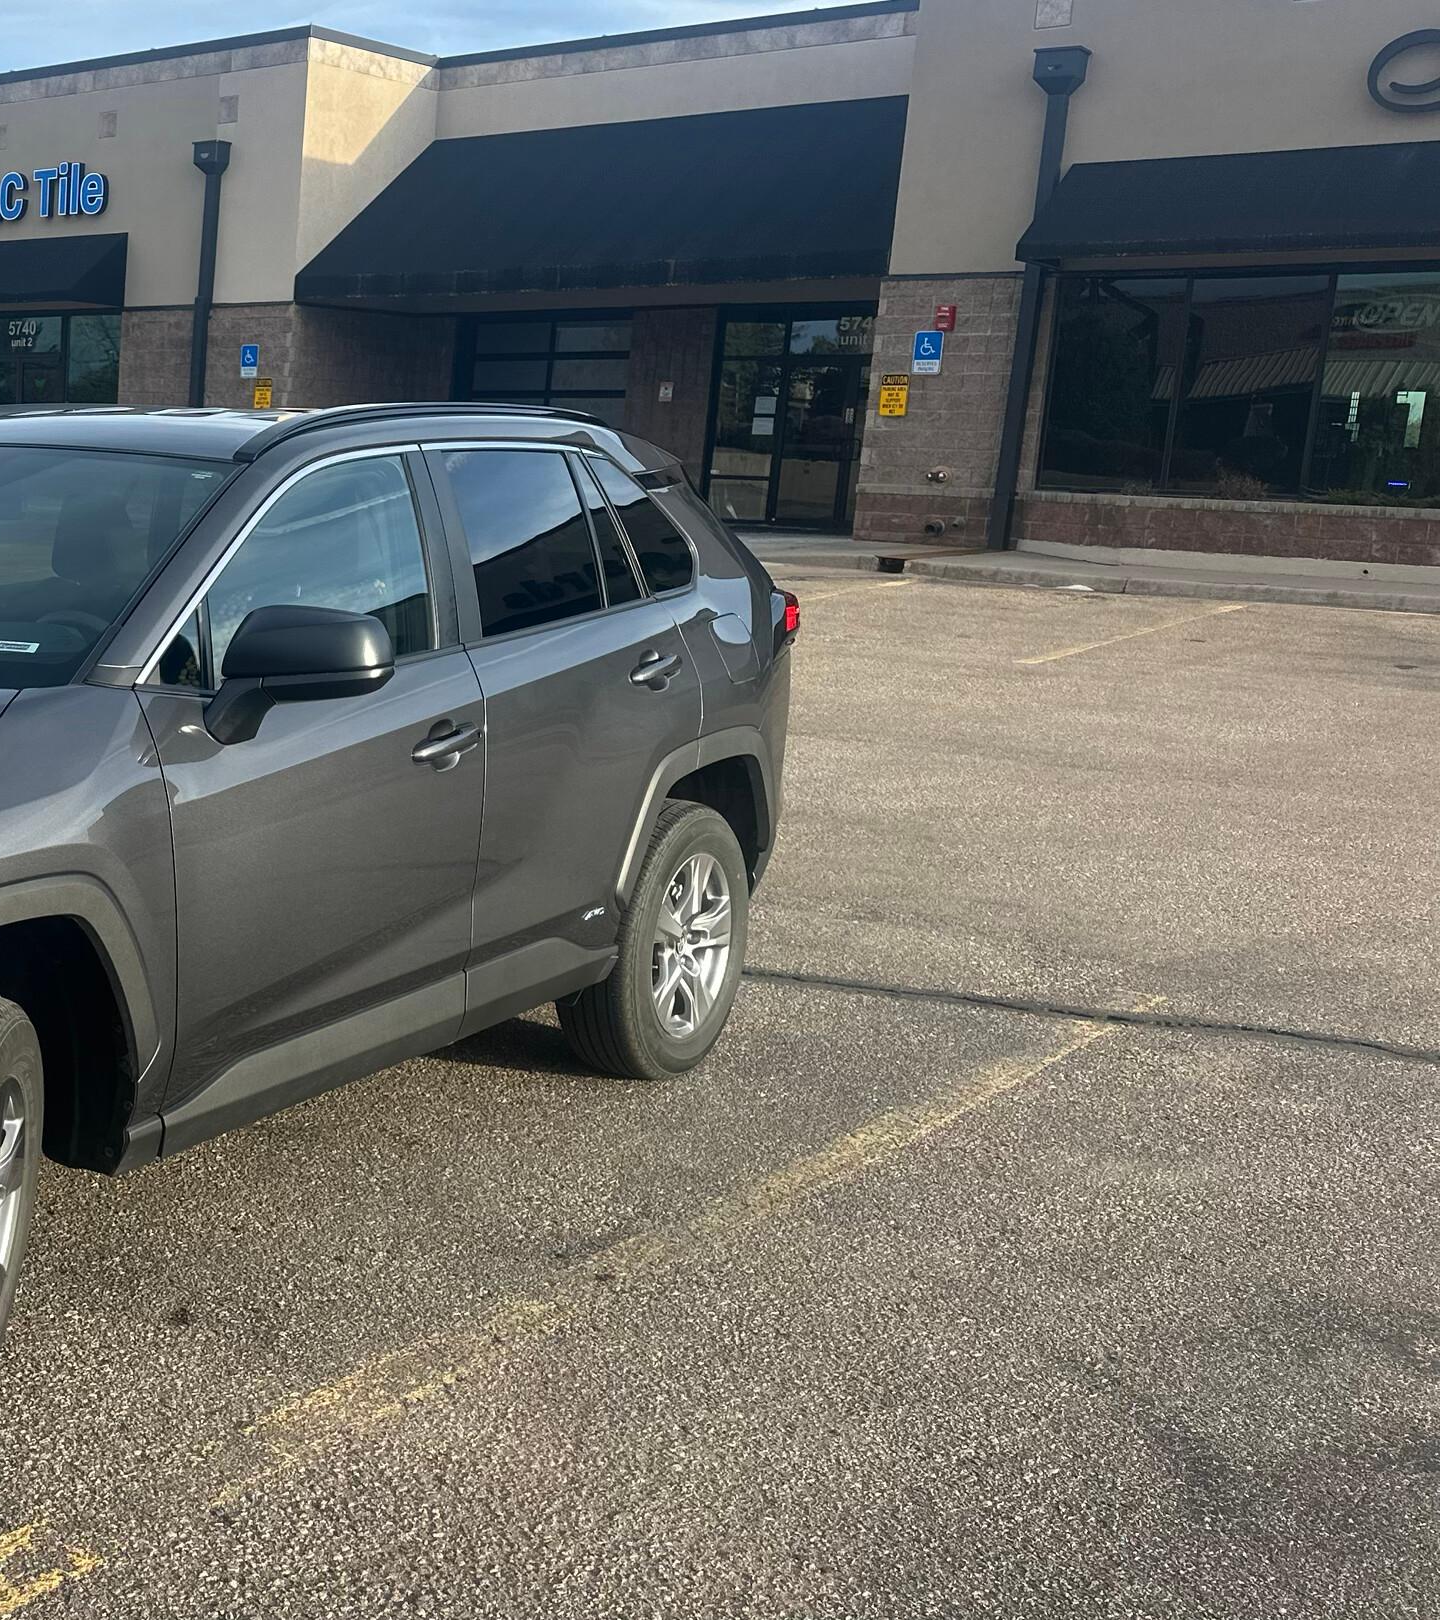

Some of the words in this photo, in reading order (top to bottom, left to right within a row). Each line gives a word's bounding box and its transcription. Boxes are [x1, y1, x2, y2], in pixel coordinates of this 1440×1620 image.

[33, 162, 106, 218] Tile
[8, 321, 36, 336] 5740
[11, 338, 26, 347] unit
[27, 338, 33, 347] 2
[883, 376, 908, 385] CAUTION
